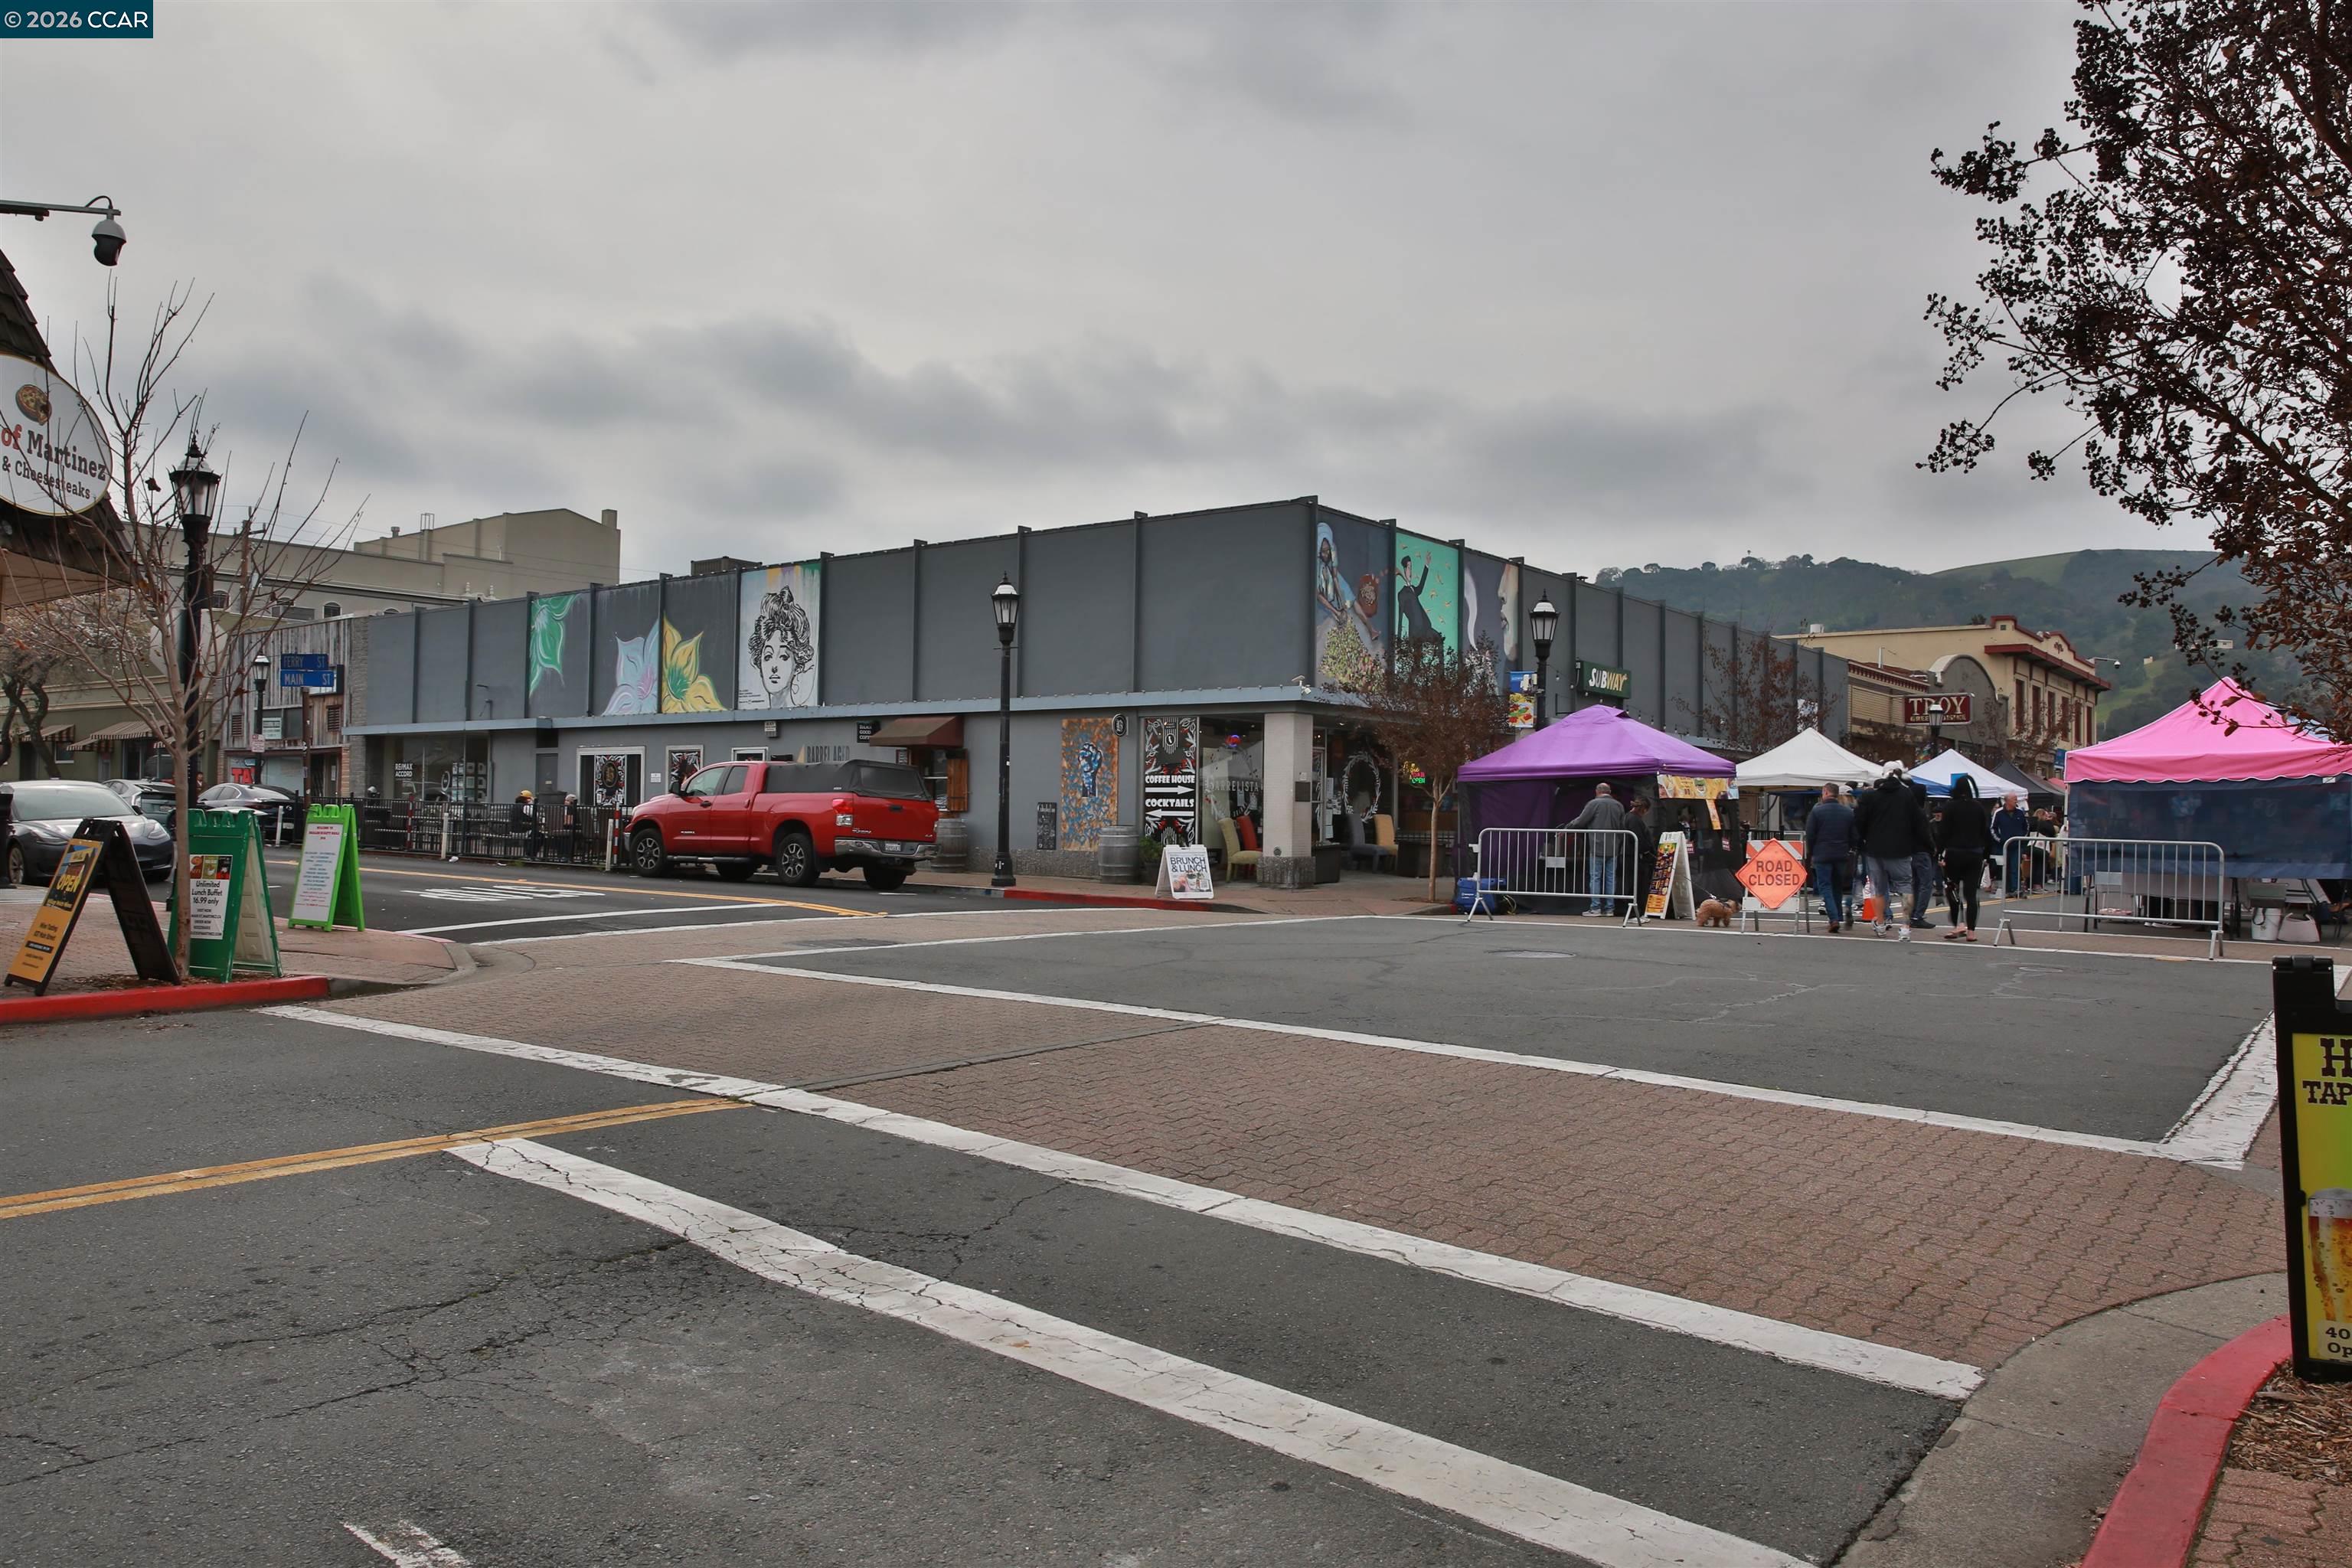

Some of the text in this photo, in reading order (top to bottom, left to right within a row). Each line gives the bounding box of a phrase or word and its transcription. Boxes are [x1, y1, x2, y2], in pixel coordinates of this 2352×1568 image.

[1, 423, 106, 481] of Martinez
[2, 455, 90, 499] & Cheesesteaks
[283, 656, 325, 668] FERRY ST
[284, 673, 331, 685] MAIN ST
[1589, 668, 1628, 691] SUBWAY
[1908, 696, 1967, 716] TROY
[395, 763, 413, 771] RE/MAX
[1145, 775, 1195, 784] COFFEE HOUSE
[1145, 799, 1194, 808] COCKTAILS
[1170, 857, 1206, 865] BRUNCH
[1756, 861, 1792, 872] ROAD
[1179, 864, 1208, 873] LUNCH
[57, 874, 80, 893] OPEN
[1749, 874, 1800, 886] CLOSED
[207, 897, 220, 906] only
[2301, 1080, 2352, 1106] TAP
[2325, 1326, 2351, 1340] 40
[2328, 1341, 2352, 1358] Op
